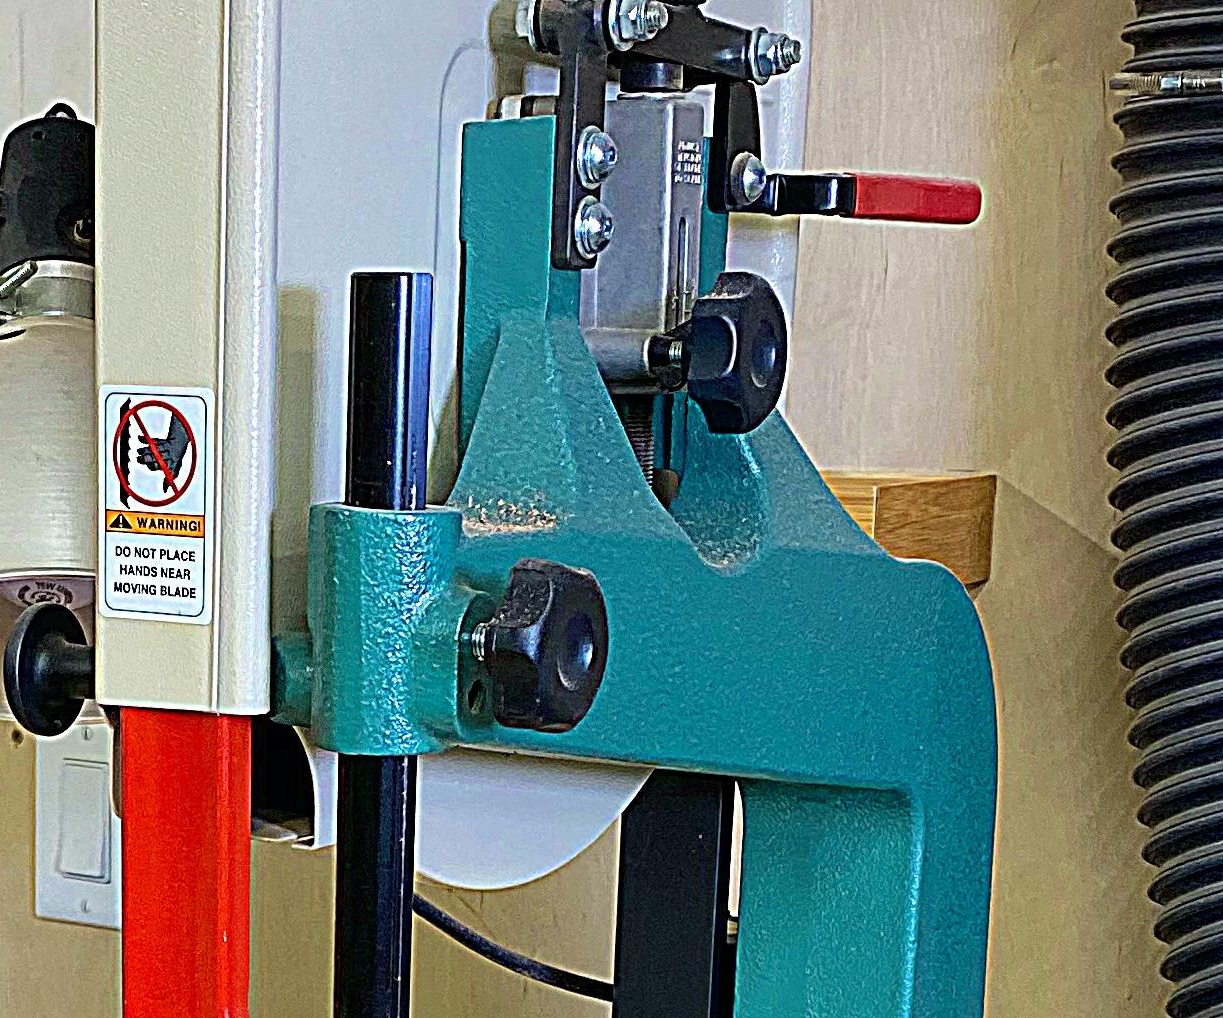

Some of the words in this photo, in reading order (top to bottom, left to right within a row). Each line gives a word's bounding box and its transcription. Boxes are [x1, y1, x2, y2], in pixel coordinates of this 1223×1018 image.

[136, 516, 201, 532] WARNING!
[115, 545, 131, 558] DO
[134, 546, 157, 560] NOT
[159, 547, 196, 563] PLACE
[119, 564, 158, 578] HANDS
[160, 566, 191, 580] NEAR
[113, 582, 157, 597] MOVING
[160, 584, 197, 599] BLADE
